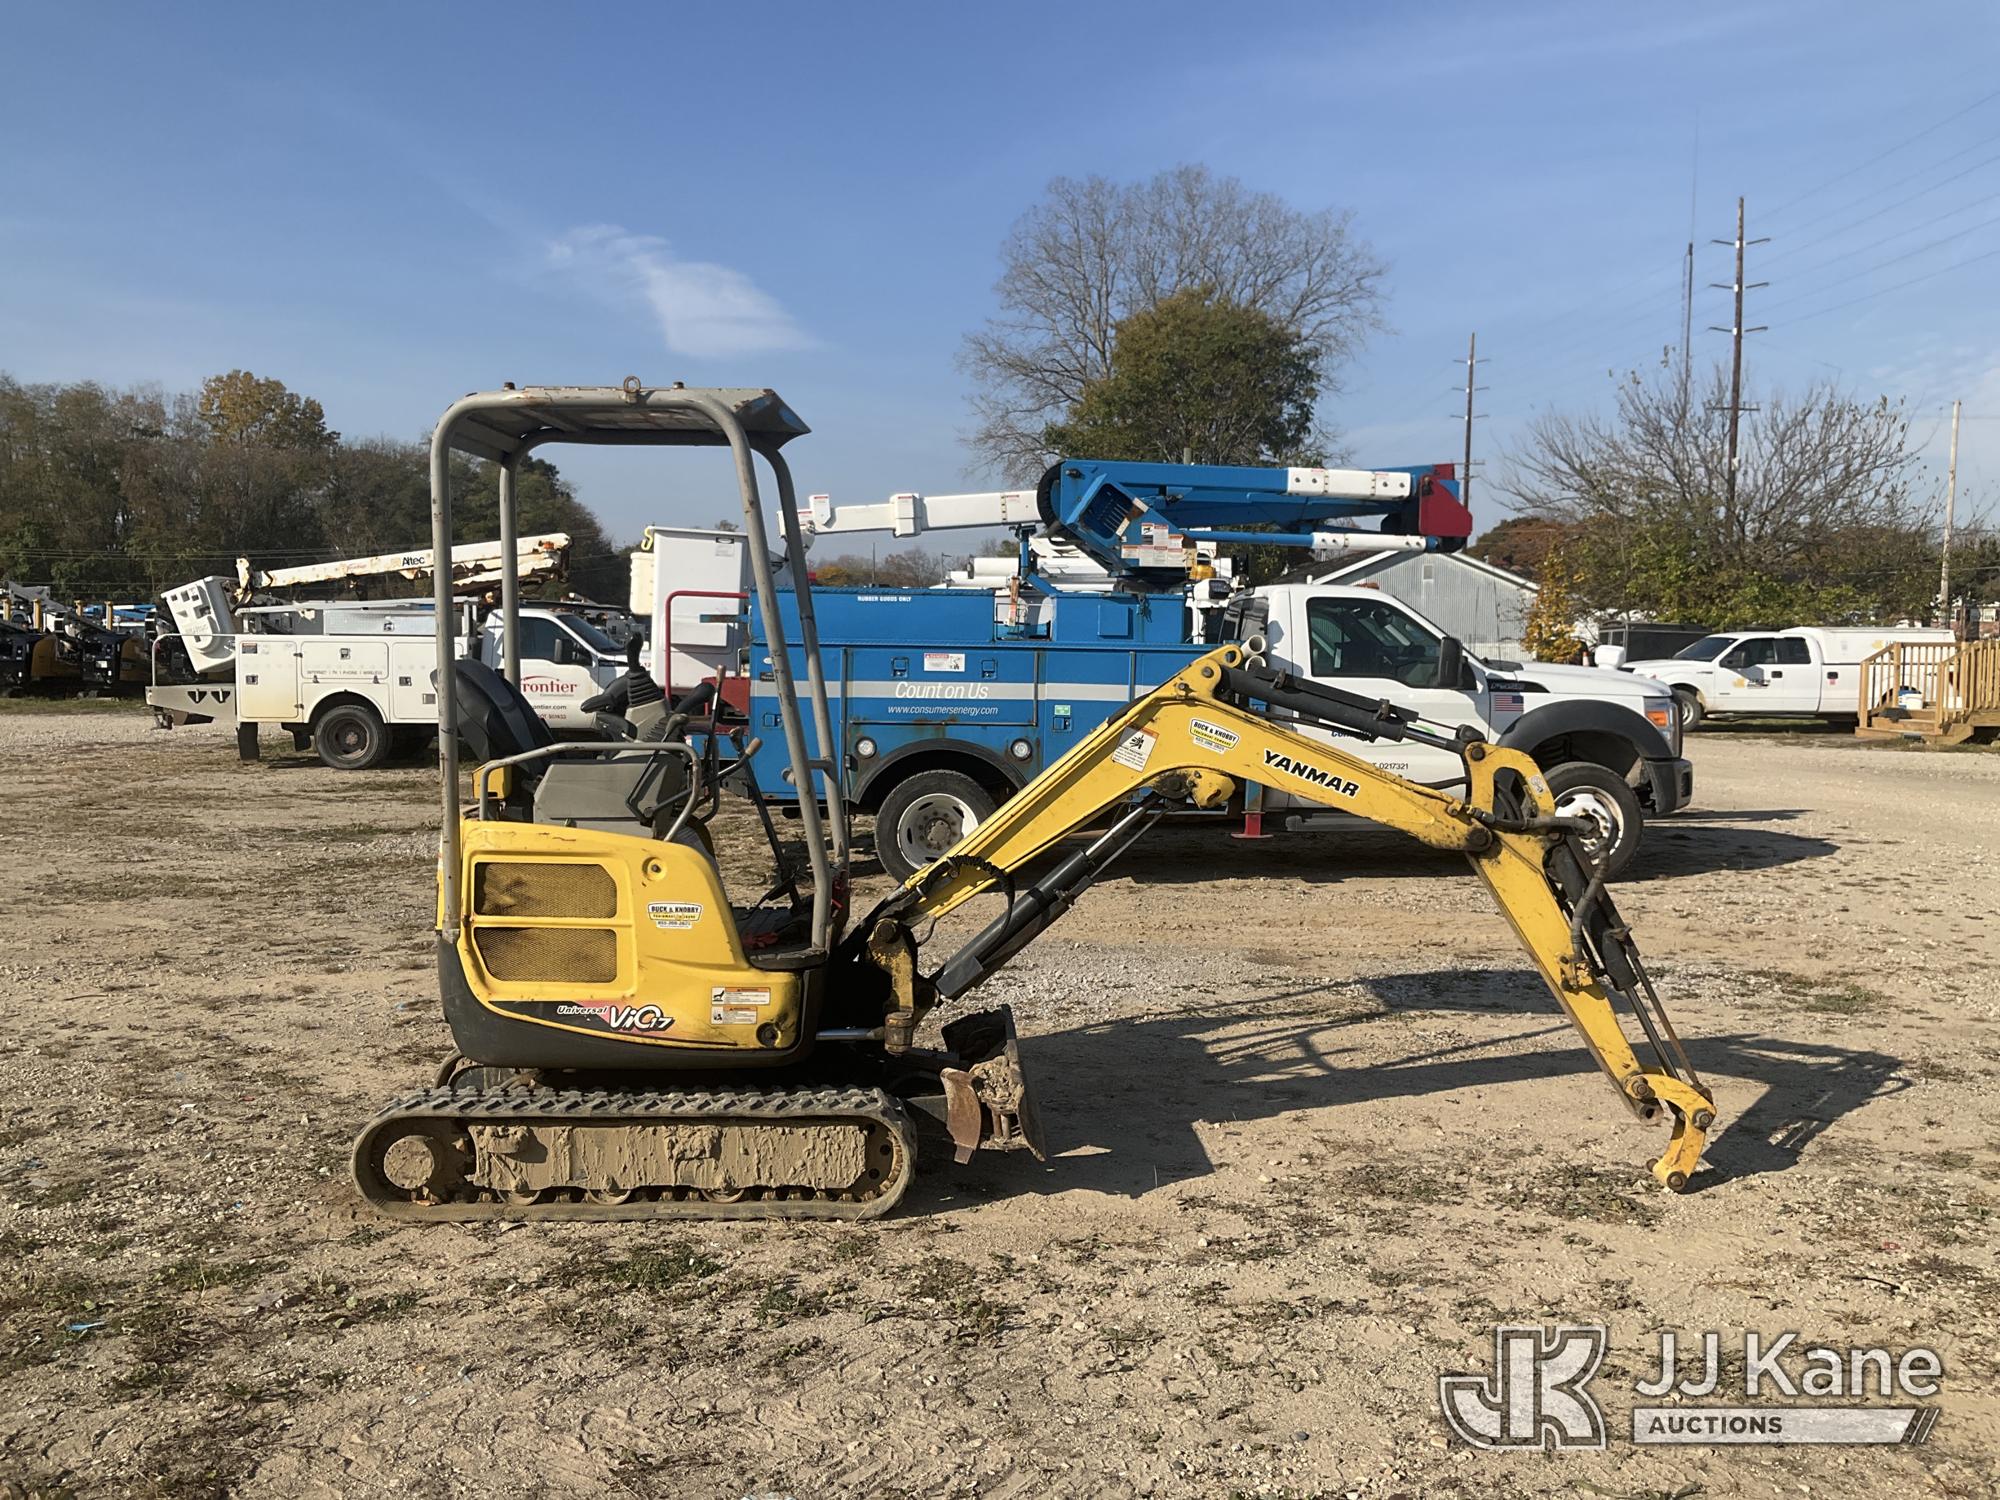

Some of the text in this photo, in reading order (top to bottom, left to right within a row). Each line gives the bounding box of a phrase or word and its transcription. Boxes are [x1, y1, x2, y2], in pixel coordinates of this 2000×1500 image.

[402, 556, 425, 567] Altec
[521, 677, 578, 693] rontier
[895, 681, 989, 699] Count on Us
[888, 705, 998, 717] www.consumersenergy.com
[1214, 729, 1237, 742] KNOBBY
[1264, 749, 1360, 797] YANMAR
[557, 1005, 608, 1015] Universal
